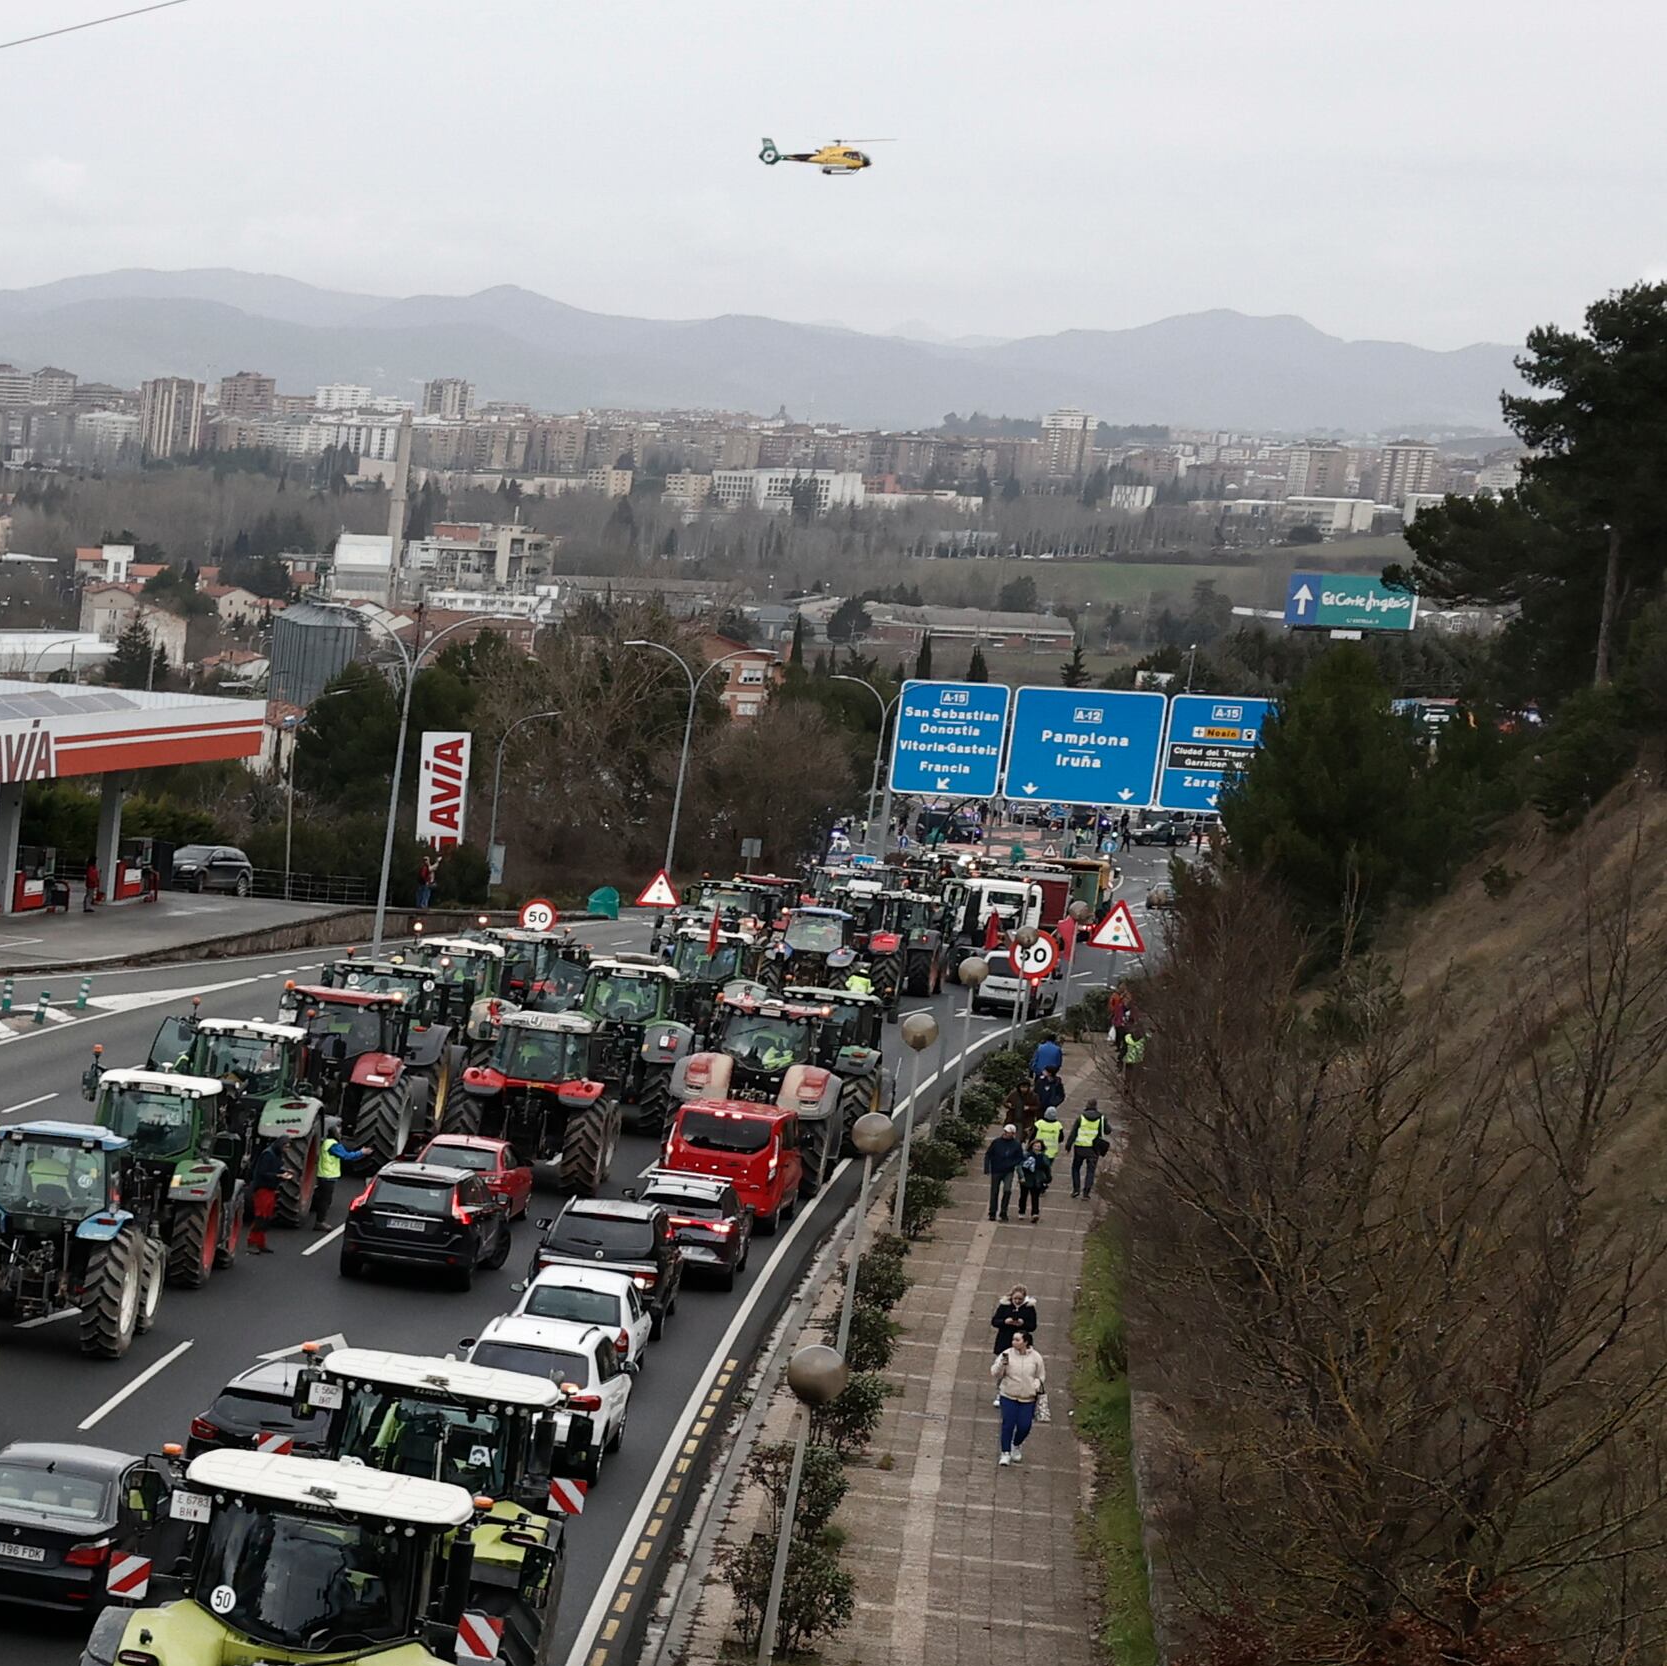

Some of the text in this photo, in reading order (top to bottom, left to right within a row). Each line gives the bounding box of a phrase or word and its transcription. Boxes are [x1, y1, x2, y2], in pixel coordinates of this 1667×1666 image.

[1321, 591, 1335, 606] El
[1335, 592, 1365, 607] Corte
[943, 693, 966, 703] A-15
[905, 706, 1000, 722] San Sebastian
[1076, 711, 1101, 721] A-12
[1215, 708, 1240, 719] A-15
[919, 723, 980, 737] Donostia
[1041, 730, 1130, 747] Pamplona
[899, 739, 998, 756] Vitoria-Gasteiz
[1173, 746, 1203, 756] Ciudad
[919, 761, 971, 774] Francia
[1056, 753, 1102, 769] Iruña
[528, 911, 548, 923] 50
[177, 1494, 210, 1508] E 6783
[216, 1590, 232, 1608] 50
